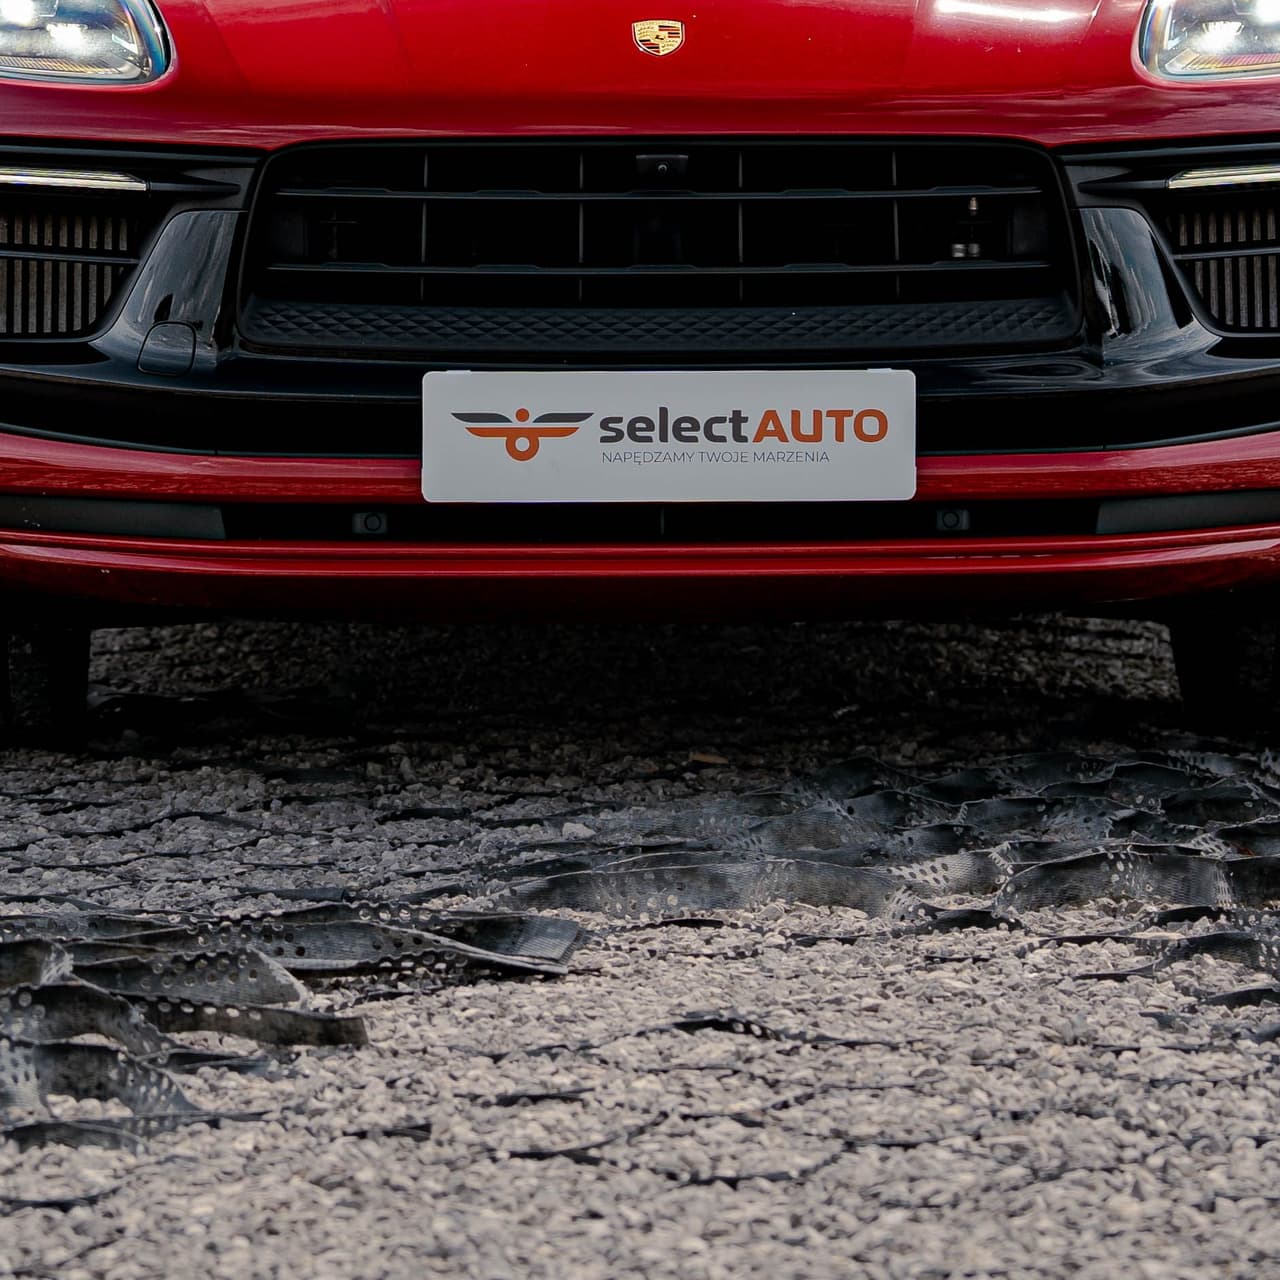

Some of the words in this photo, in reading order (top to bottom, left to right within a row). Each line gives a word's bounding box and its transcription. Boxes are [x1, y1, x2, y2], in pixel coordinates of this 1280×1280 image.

[599, 406, 889, 443] selectAUTO
[602, 451, 695, 466] NAPĘDZAMY
[697, 451, 749, 463] TWOJE
[753, 451, 830, 463] MARZENIA
